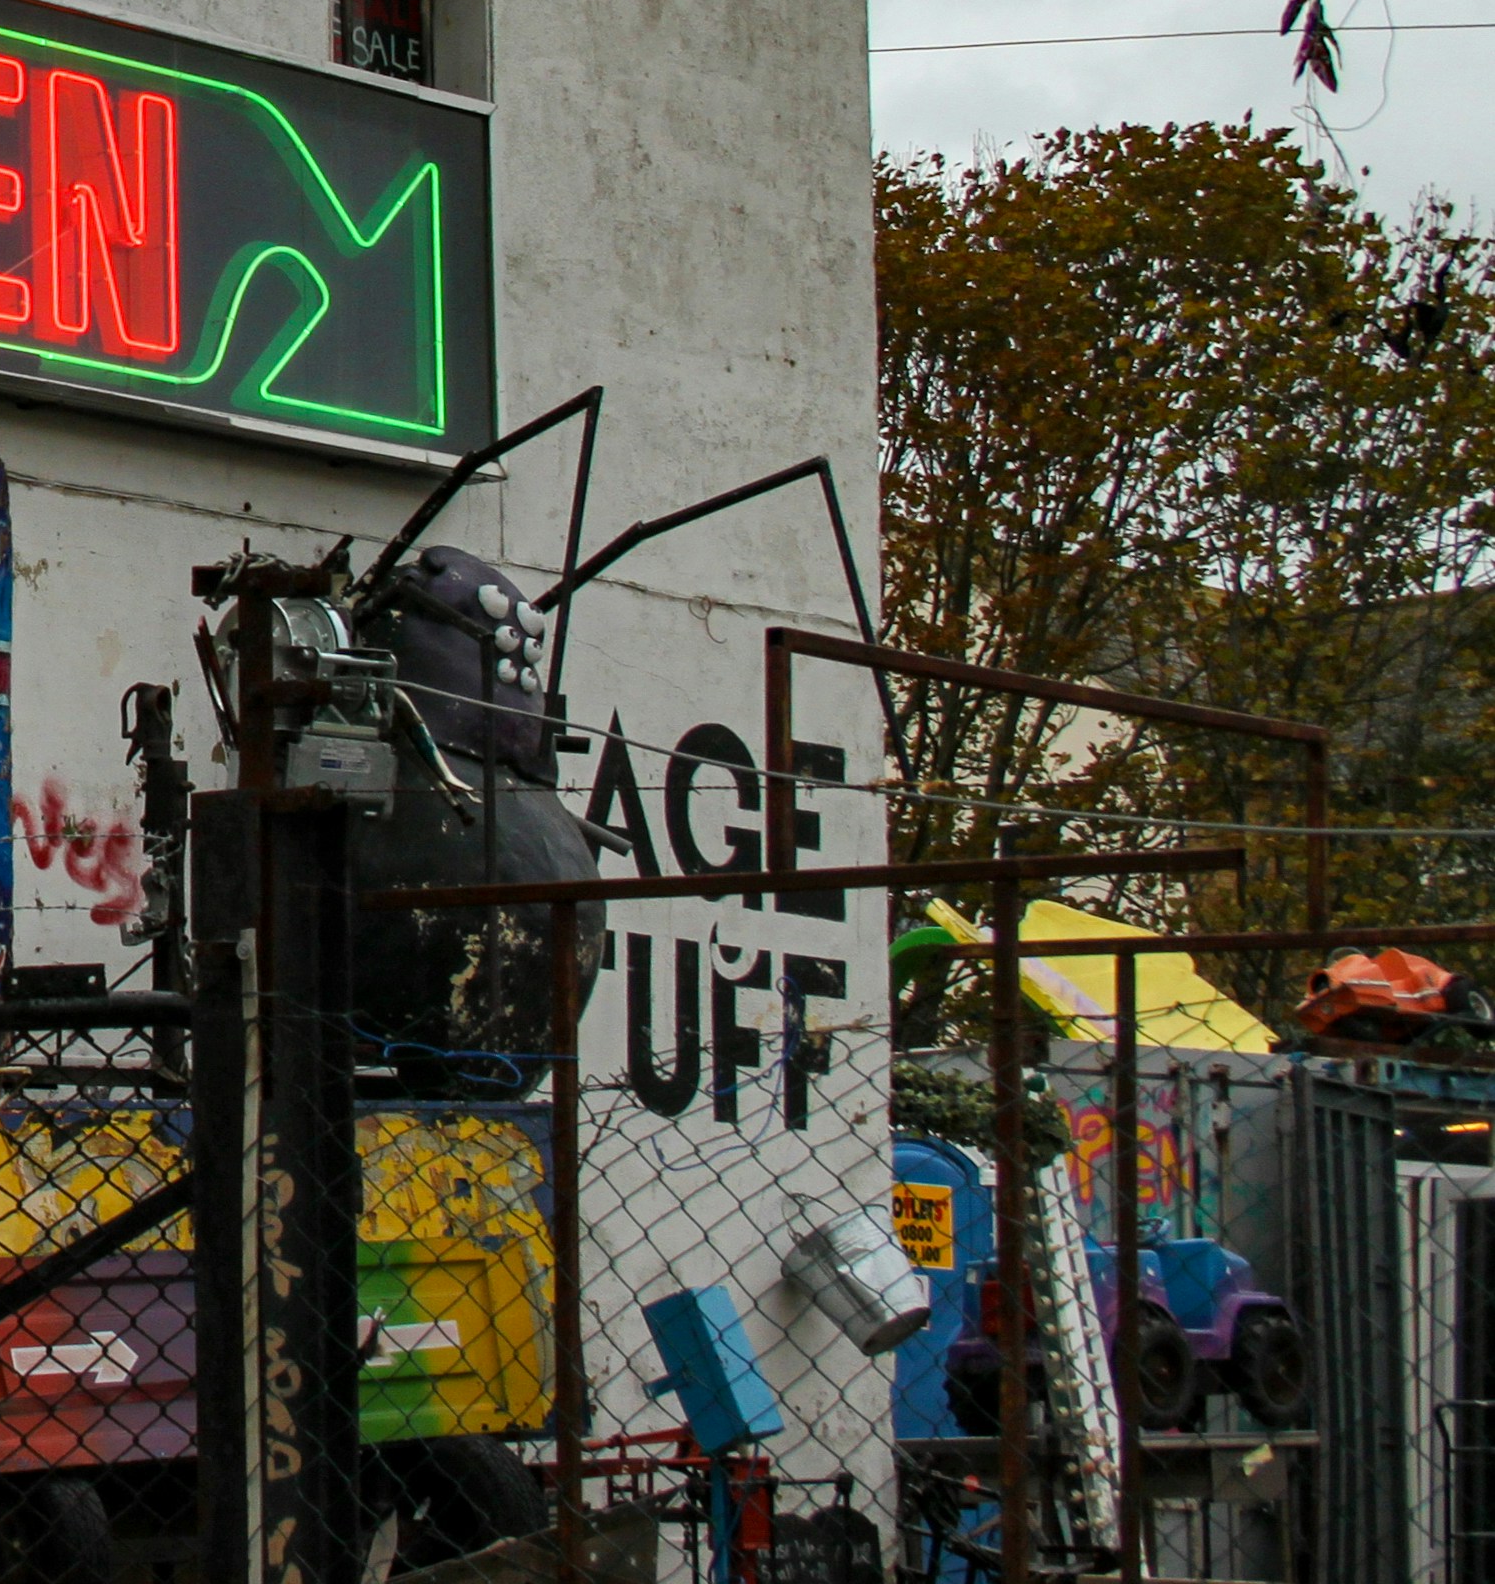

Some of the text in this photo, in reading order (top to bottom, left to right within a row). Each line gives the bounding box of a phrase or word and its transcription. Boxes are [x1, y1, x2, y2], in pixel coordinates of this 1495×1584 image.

[352, 26, 421, 72] SALE
[544, 694, 846, 923] AGE
[599, 928, 846, 1131] UFF
